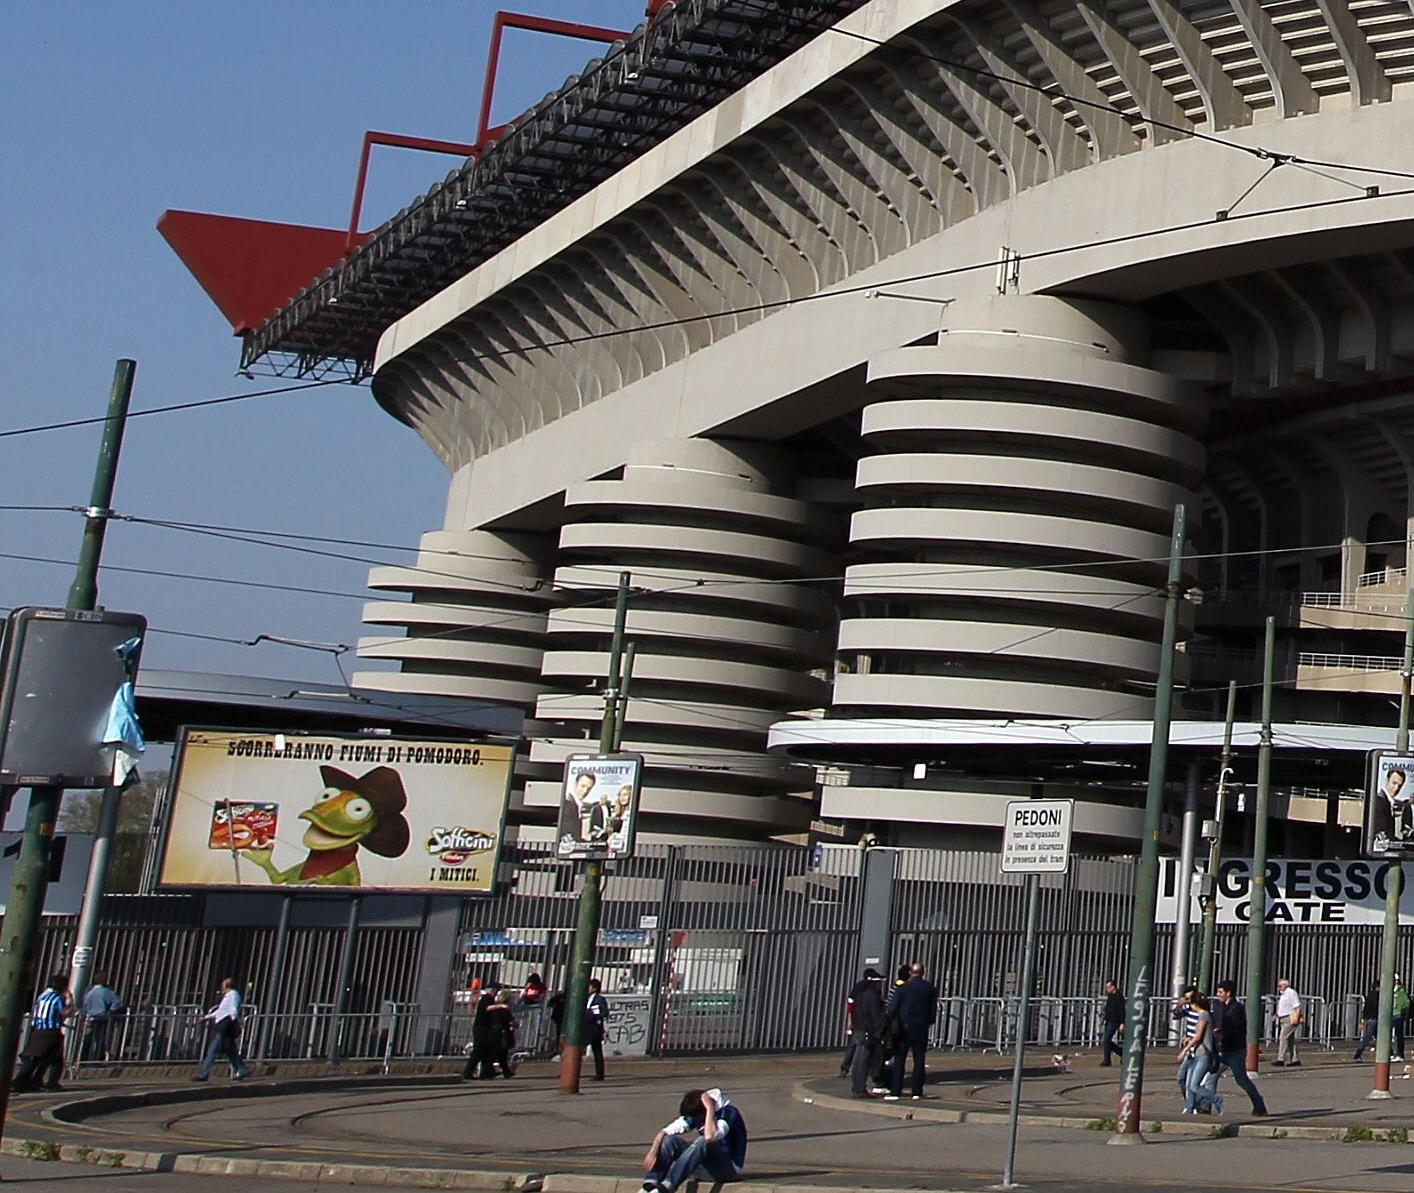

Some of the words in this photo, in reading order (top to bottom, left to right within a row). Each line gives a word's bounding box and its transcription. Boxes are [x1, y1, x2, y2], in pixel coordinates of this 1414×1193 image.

[339, 745, 383, 763] FIUMI
[386, 747, 402, 763] DI
[571, 766, 631, 776] COMMUNITY
[1014, 809, 1062, 826] PEDONI
[430, 827, 497, 853] Sofficini
[1163, 859, 1406, 900] IGRESSO
